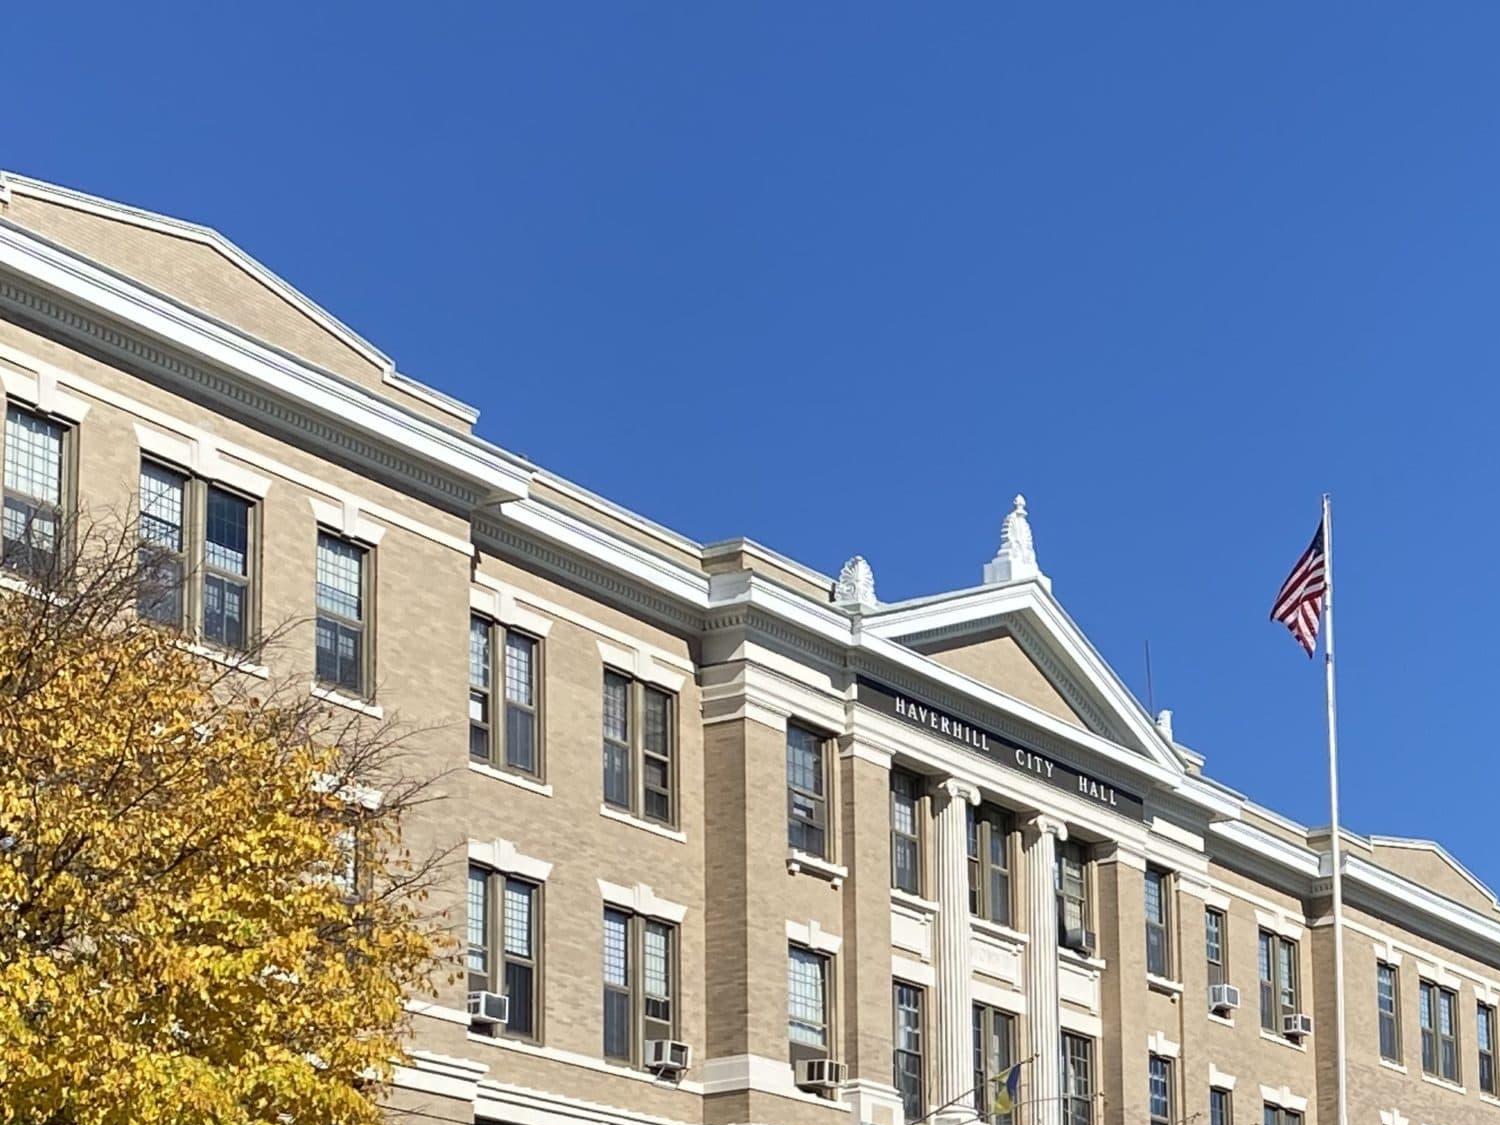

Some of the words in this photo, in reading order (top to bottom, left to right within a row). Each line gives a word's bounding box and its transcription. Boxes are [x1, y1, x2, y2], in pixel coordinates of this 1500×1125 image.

[896, 697, 989, 751] HAVERHILL
[1015, 749, 1054, 778] CITY
[1079, 775, 1117, 805] HALL
